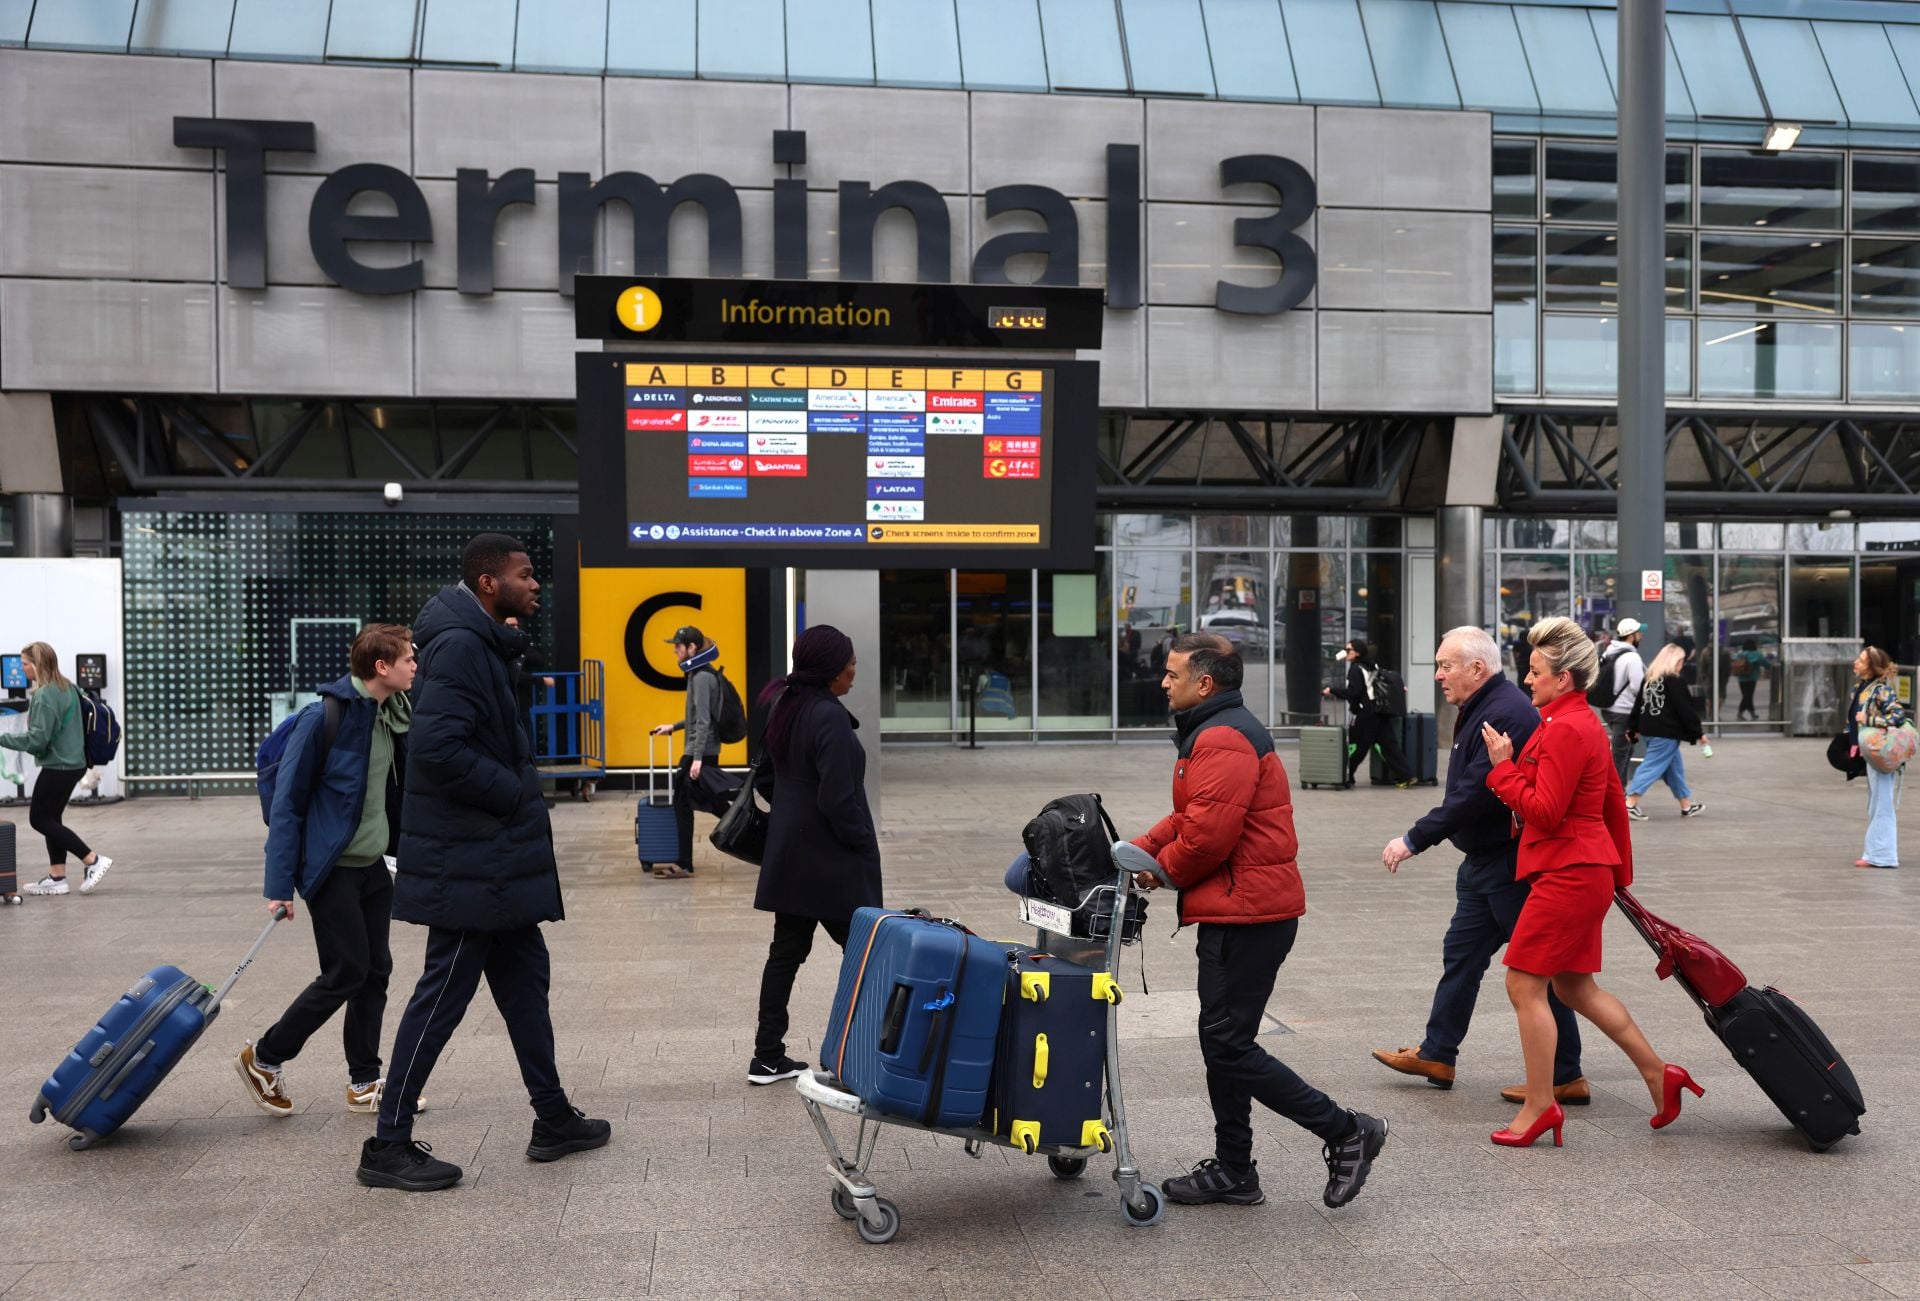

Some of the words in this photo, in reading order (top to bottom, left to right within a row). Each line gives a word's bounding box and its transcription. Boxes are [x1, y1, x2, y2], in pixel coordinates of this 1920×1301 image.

[174, 117, 1139, 307] Terminal
[1216, 154, 1318, 314] 3
[722, 299, 890, 328] Information
[648, 366, 666, 384] A
[712, 367, 726, 384] B
[771, 368, 786, 386] C
[832, 370, 846, 386] D
[892, 370, 902, 388] E
[952, 371, 962, 388] F
[1006, 372, 1022, 389] G
[932, 396, 977, 407] Emirates
[682, 527, 738, 536] Assistance
[744, 528, 776, 536] Check
[778, 528, 789, 536] in
[790, 528, 822, 537] above
[825, 528, 851, 537] Zone
[854, 528, 862, 537] A
[624, 591, 702, 691] C
